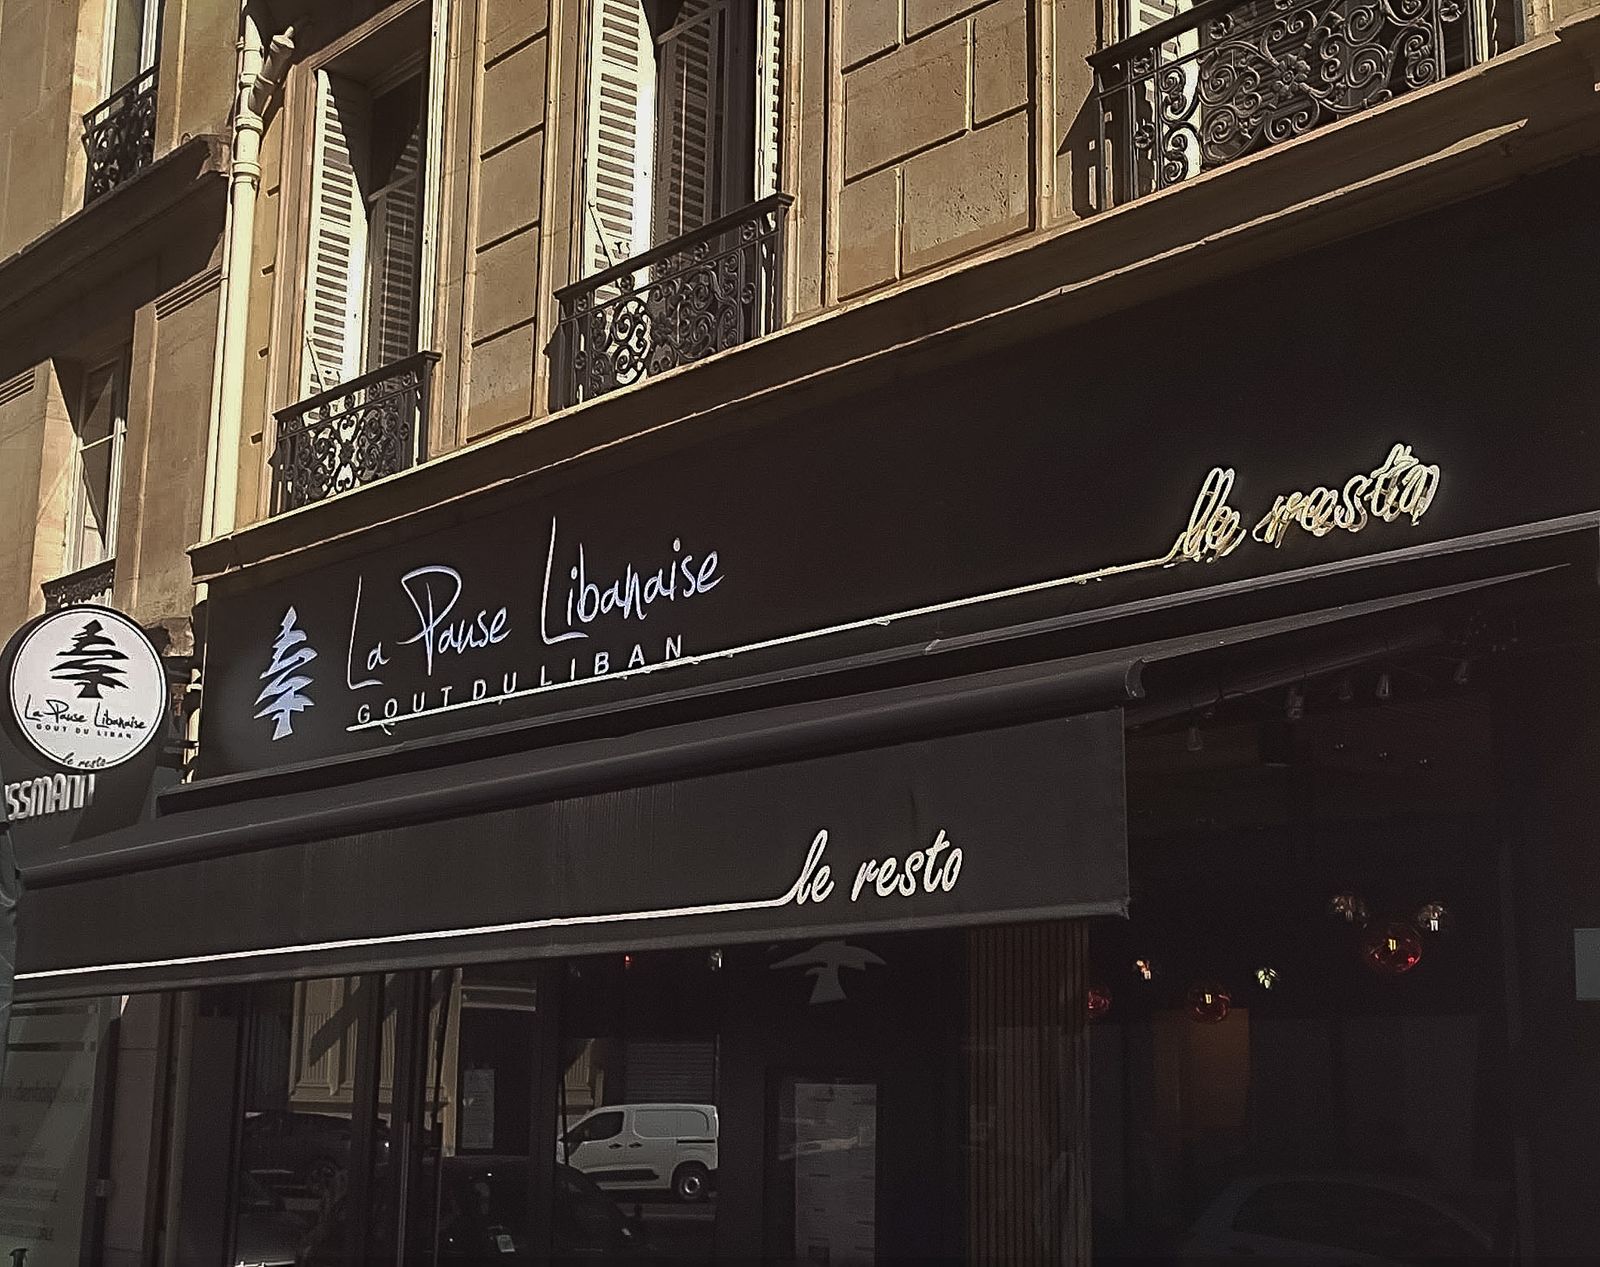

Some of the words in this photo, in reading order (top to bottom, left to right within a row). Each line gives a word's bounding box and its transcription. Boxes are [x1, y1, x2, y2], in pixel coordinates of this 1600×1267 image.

[346, 575, 391, 690] La
[396, 564, 513, 676] Pause
[540, 515, 726, 645] Libanaise
[356, 686, 455, 725] GOUT
[539, 634, 684, 687] LIBAN
[24, 693, 43, 722] La
[43, 699, 88, 724] Pause
[93, 701, 148, 730] Libanaise
[36, 723, 68, 733] GOUT
[75, 728, 90, 736] DU
[97, 730, 132, 739] LIBAN
[62, 751, 75, 766] le
[77, 757, 107, 769] resto
[785, 829, 835, 905] le
[851, 829, 963, 902] resto
